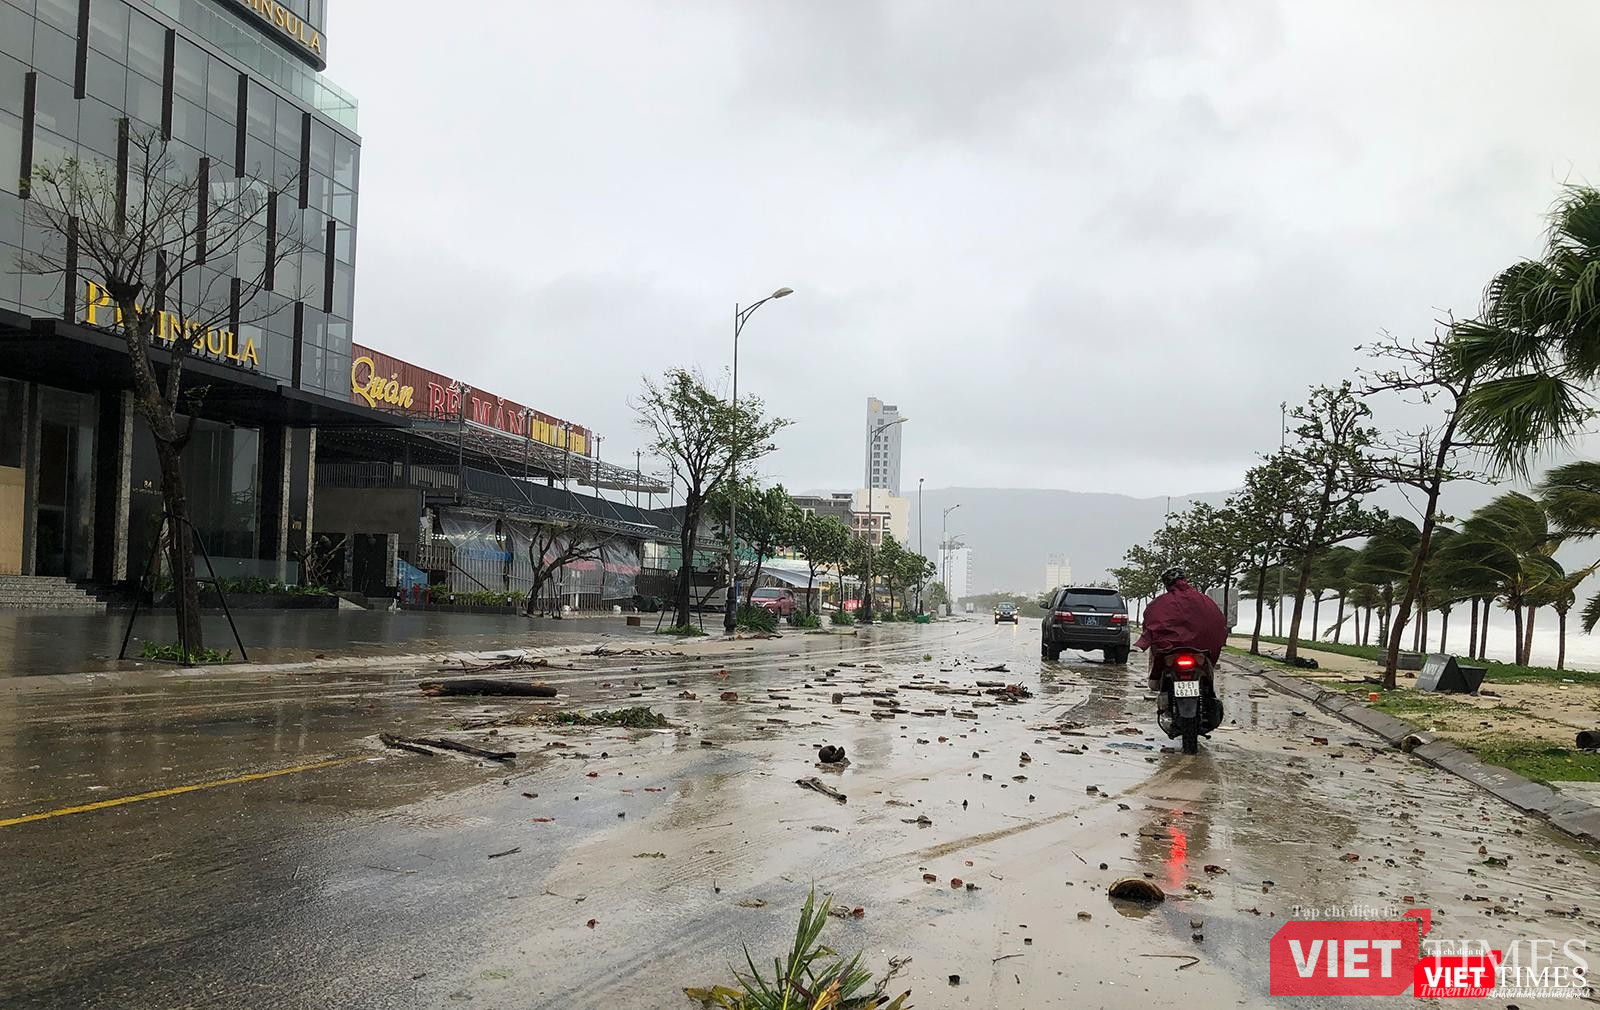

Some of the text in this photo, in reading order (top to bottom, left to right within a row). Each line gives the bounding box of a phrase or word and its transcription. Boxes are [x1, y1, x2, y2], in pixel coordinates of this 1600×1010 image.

[245, 0, 321, 54] INSULA
[86, 281, 259, 366] PINSULA
[351, 356, 414, 408] Quán
